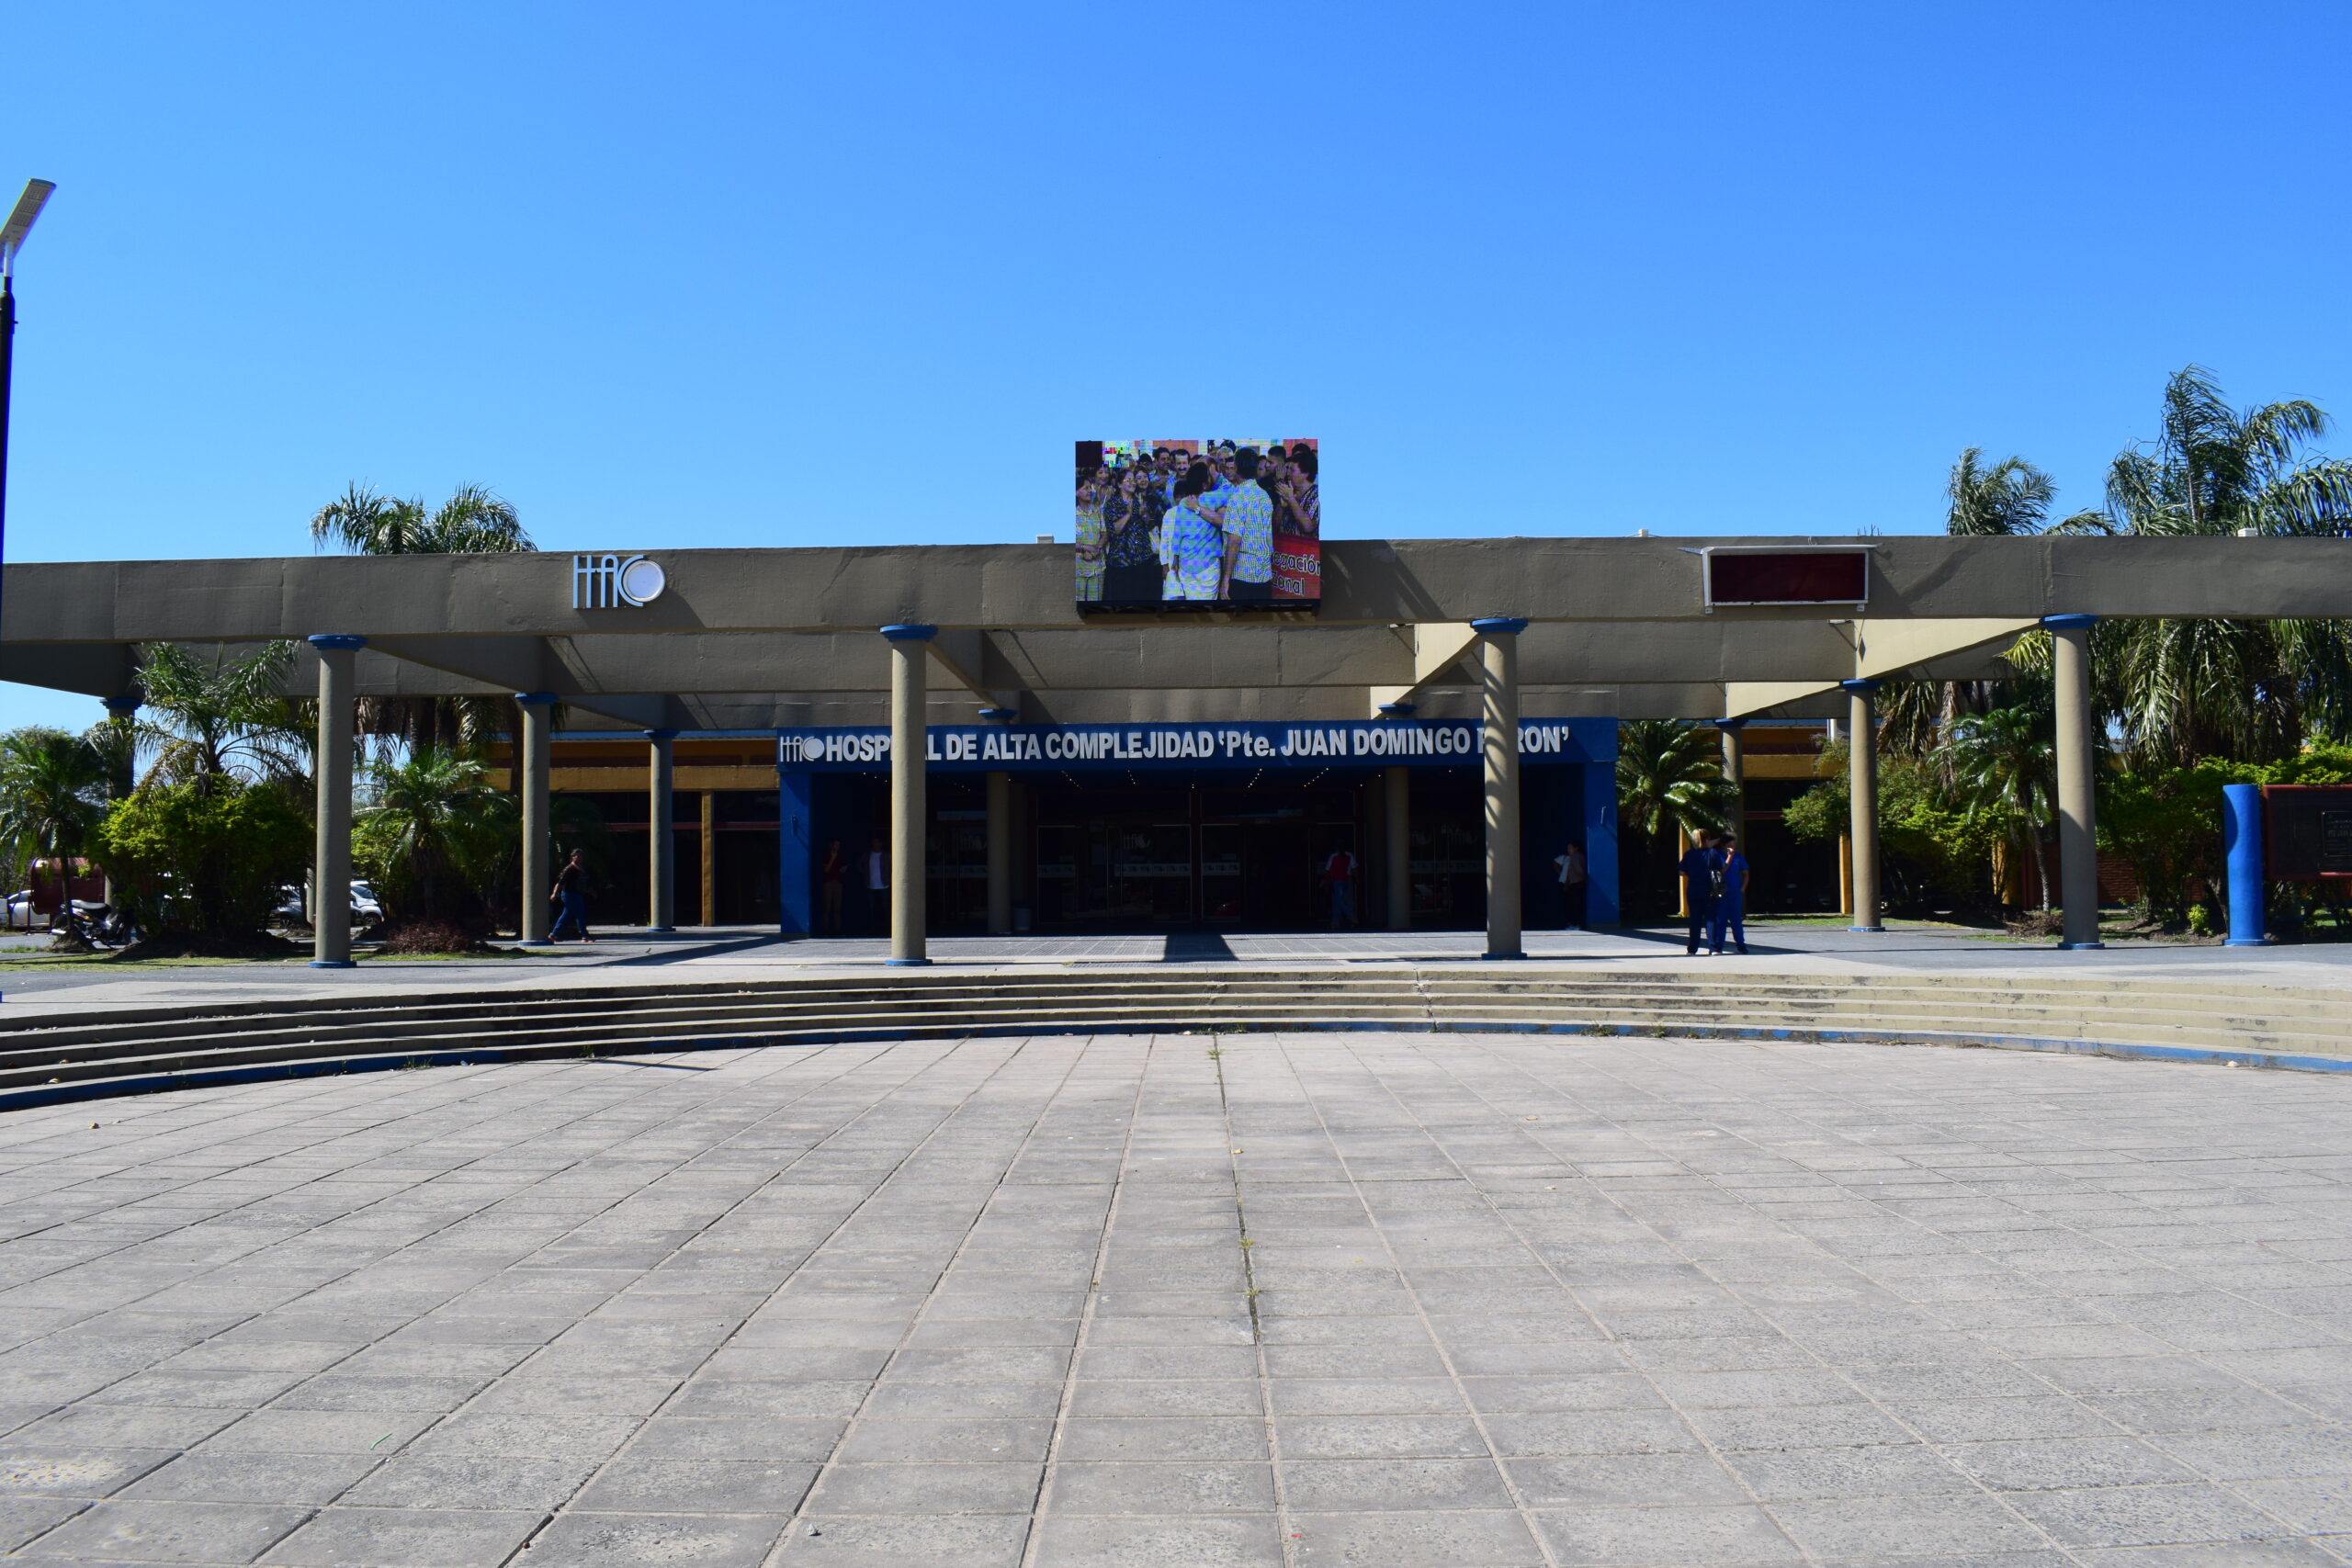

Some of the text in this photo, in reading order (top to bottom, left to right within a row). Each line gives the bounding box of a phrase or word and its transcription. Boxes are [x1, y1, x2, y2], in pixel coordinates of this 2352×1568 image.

[1272, 570, 1305, 597] Zonal
[826, 734, 942, 761] HOSPL
[945, 734, 978, 761] DE
[982, 733, 1042, 761] ALTA
[1045, 731, 1215, 760] COMPLEJIDAD
[1280, 729, 1347, 756] JUAN
[1353, 727, 1471, 755] DOMINGO
[1476, 726, 1569, 754] PRON'
